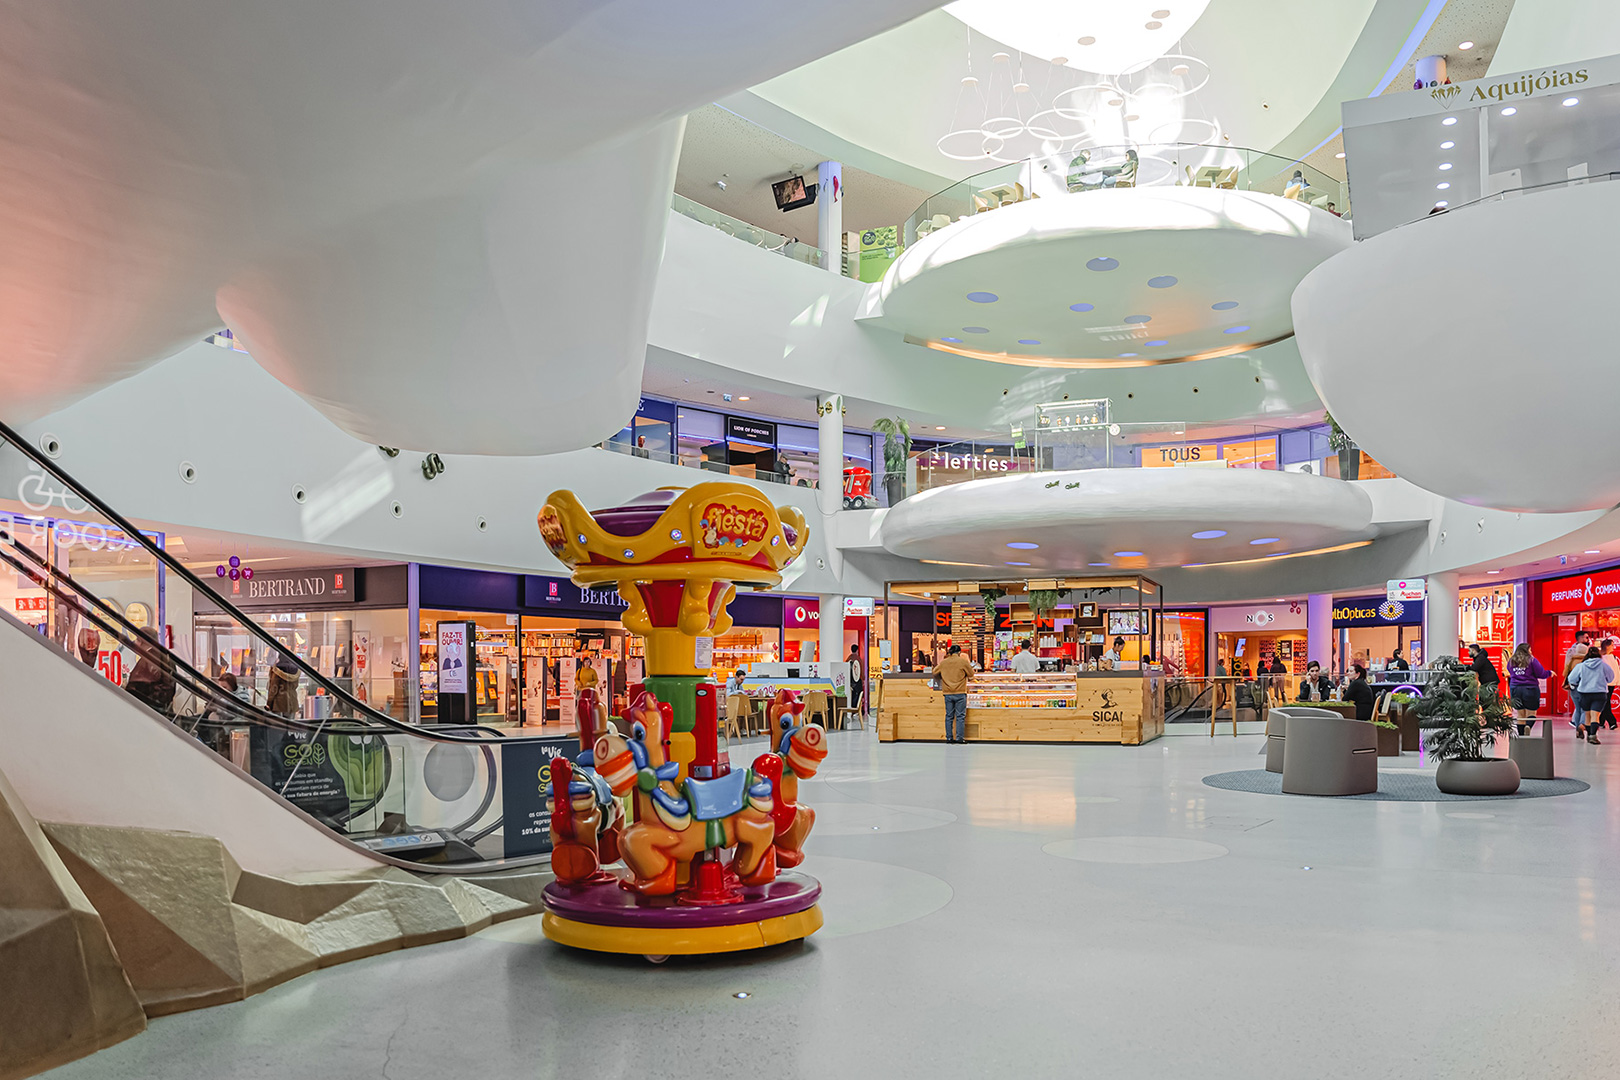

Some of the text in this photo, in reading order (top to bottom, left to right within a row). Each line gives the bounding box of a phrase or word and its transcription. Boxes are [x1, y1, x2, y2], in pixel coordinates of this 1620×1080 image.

[1469, 68, 1589, 102] Aquijóias
[944, 451, 1008, 472] lefties
[1160, 447, 1200, 462] TOUS
[707, 507, 766, 539] fiesta
[249, 577, 326, 599] BERTRAND
[1551, 588, 1583, 602] PERFUMES
[1246, 610, 1275, 627] NOS
[442, 631, 463, 639] FAZ-TE
